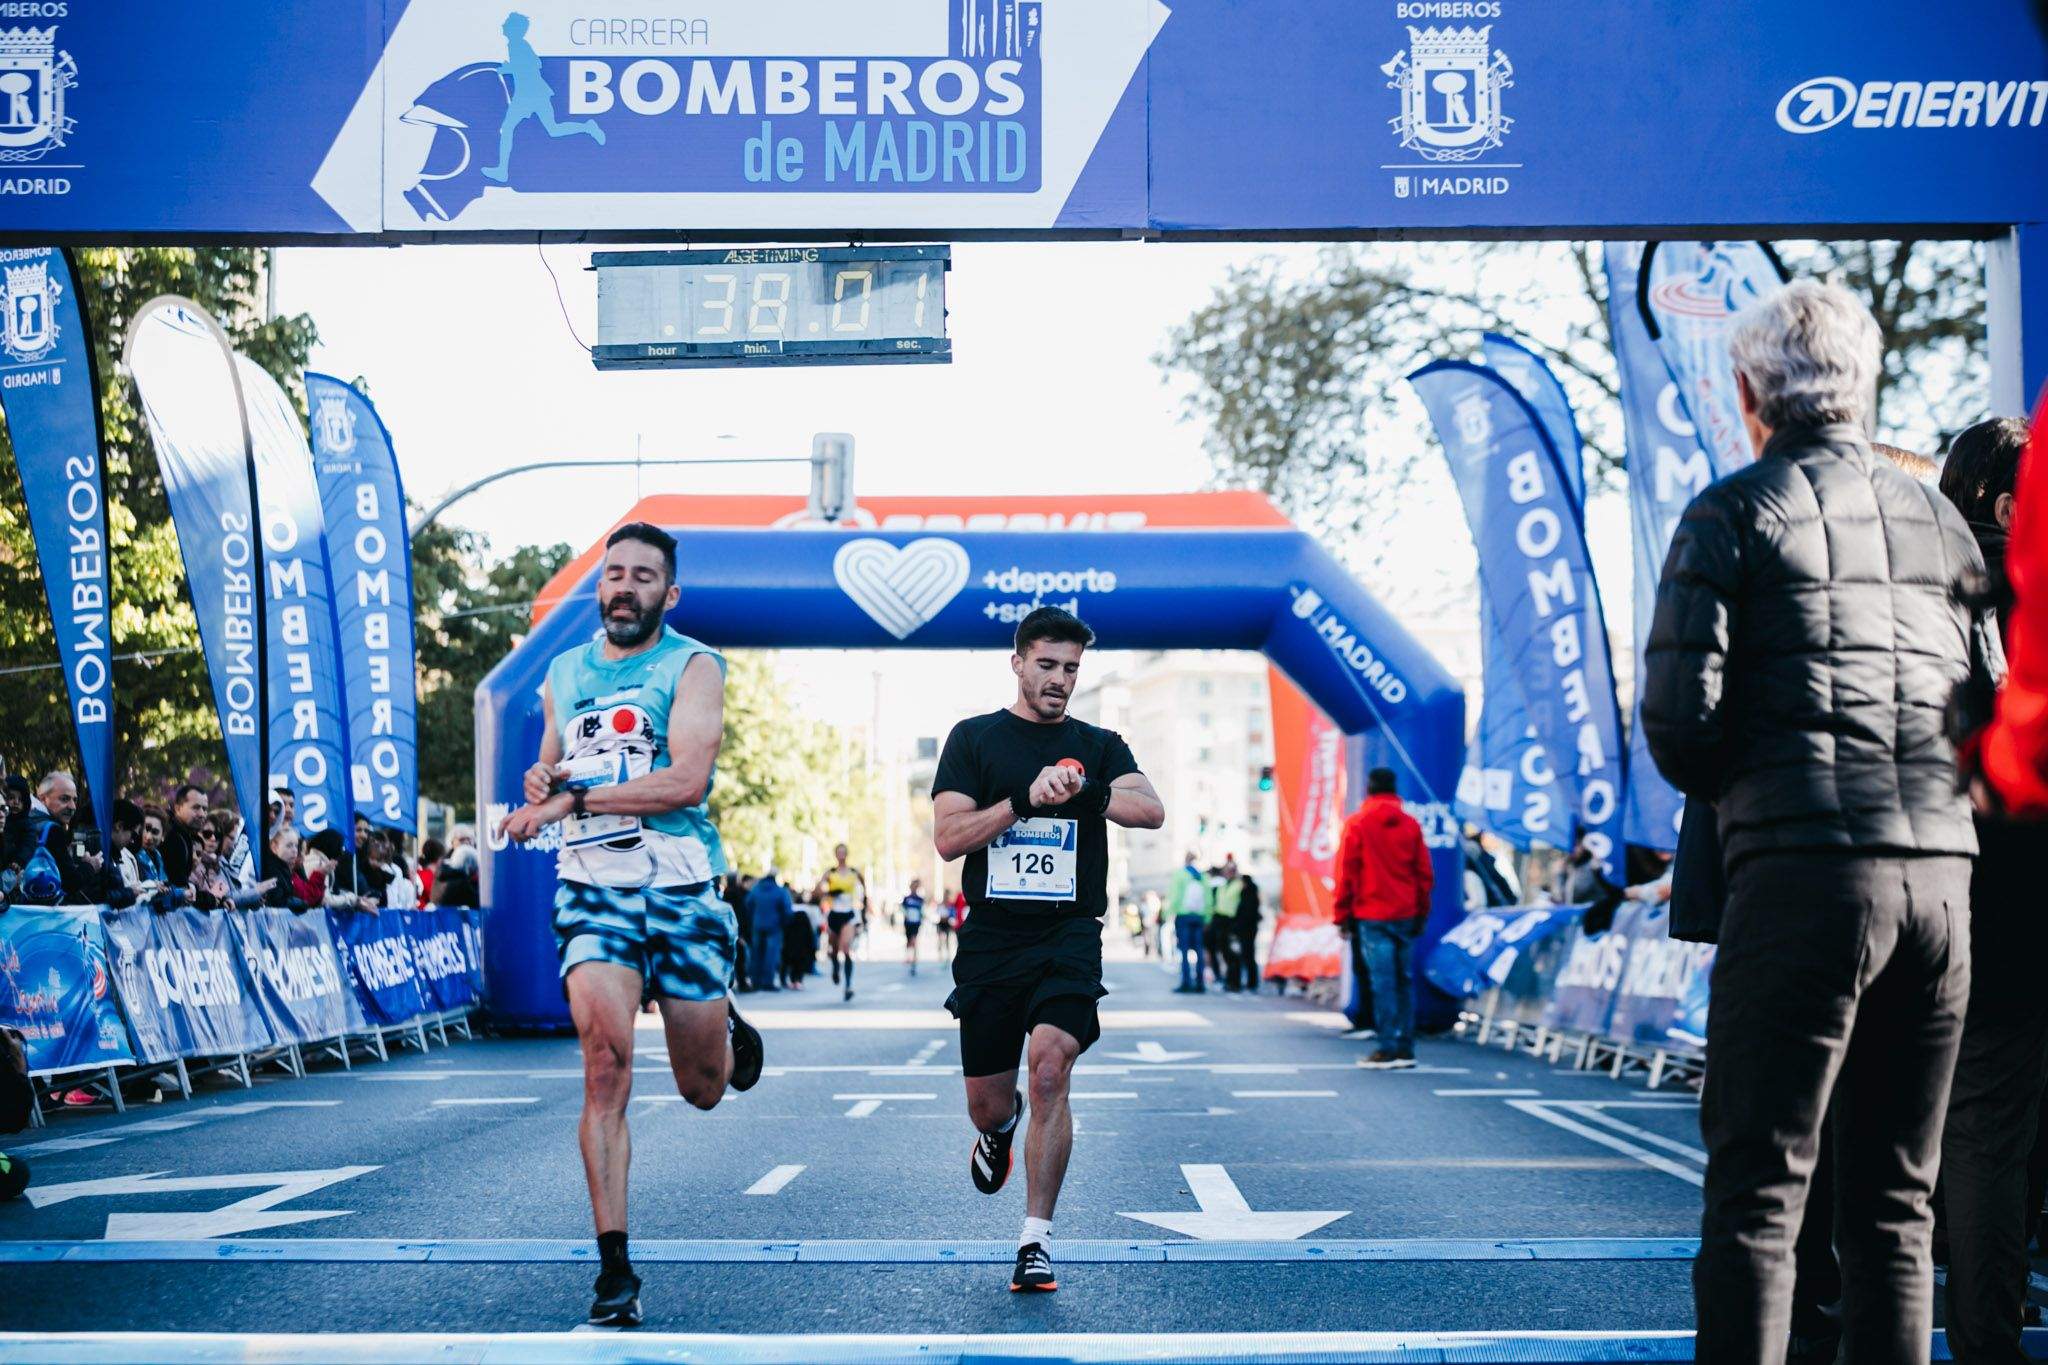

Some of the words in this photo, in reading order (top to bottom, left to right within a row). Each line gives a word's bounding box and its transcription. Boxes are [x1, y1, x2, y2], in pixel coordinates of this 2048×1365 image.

[1397, 1, 1502, 19] BOMBEROS
[570, 18, 709, 46] CARRERA
[567, 58, 1025, 116] BOMBEROS
[743, 120, 804, 183] de
[825, 120, 1027, 183] MADRID
[0, 178, 72, 195] ADRID
[1422, 176, 1510, 196] MADRID
[648, 345, 678, 356] hour
[744, 342, 771, 354] min.
[896, 339, 922, 349] sec.
[982, 565, 1117, 599] +deporte
[1316, 614, 1407, 704] MADRID
[1011, 852, 1055, 875] 126
